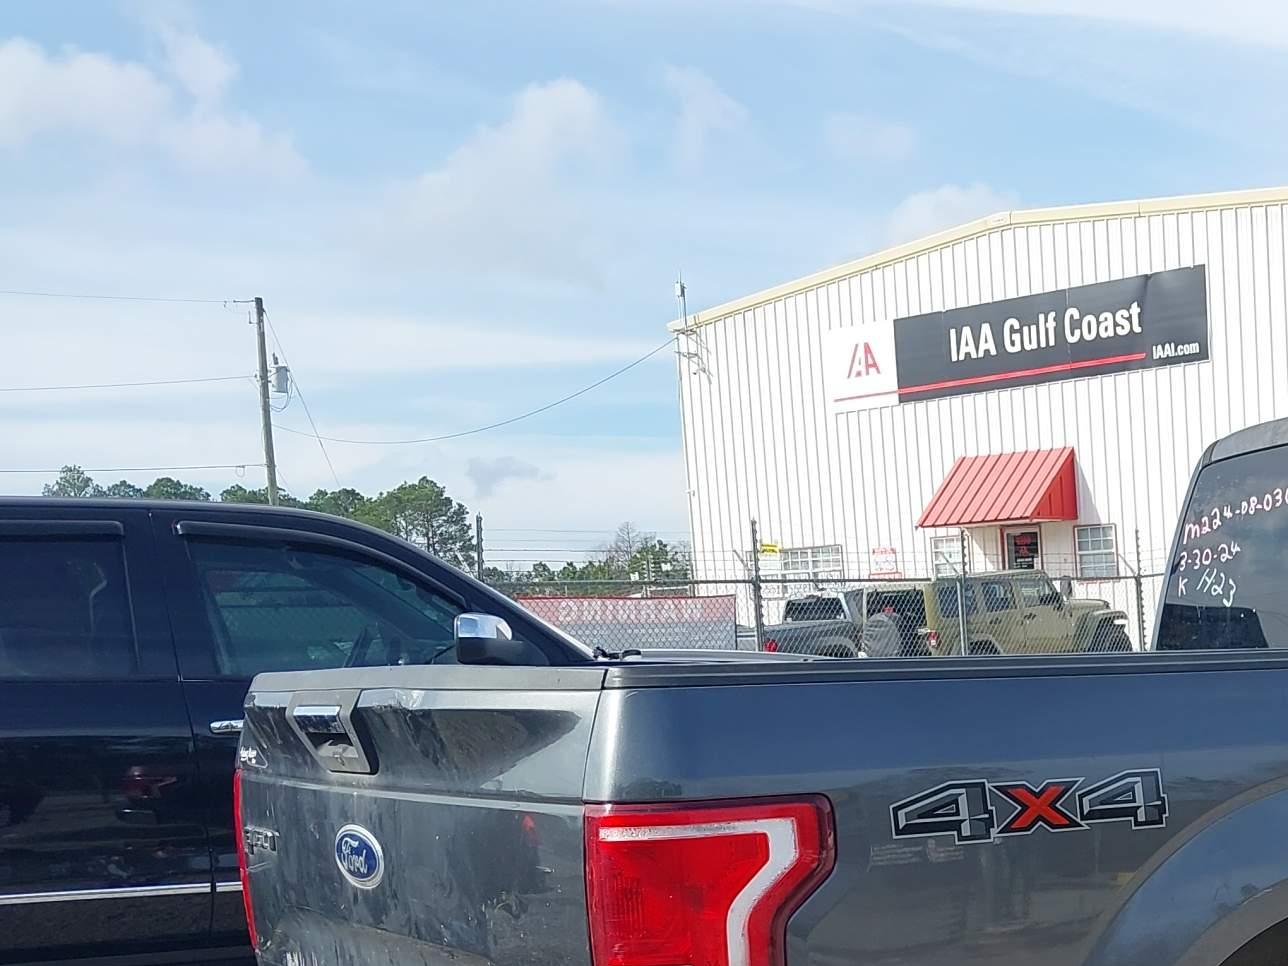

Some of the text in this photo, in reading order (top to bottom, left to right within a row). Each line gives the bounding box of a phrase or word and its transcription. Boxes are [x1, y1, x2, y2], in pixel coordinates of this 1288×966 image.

[950, 301, 1142, 362] IAA Gulf Coast
[1152, 342, 1200, 360] IAAI.com
